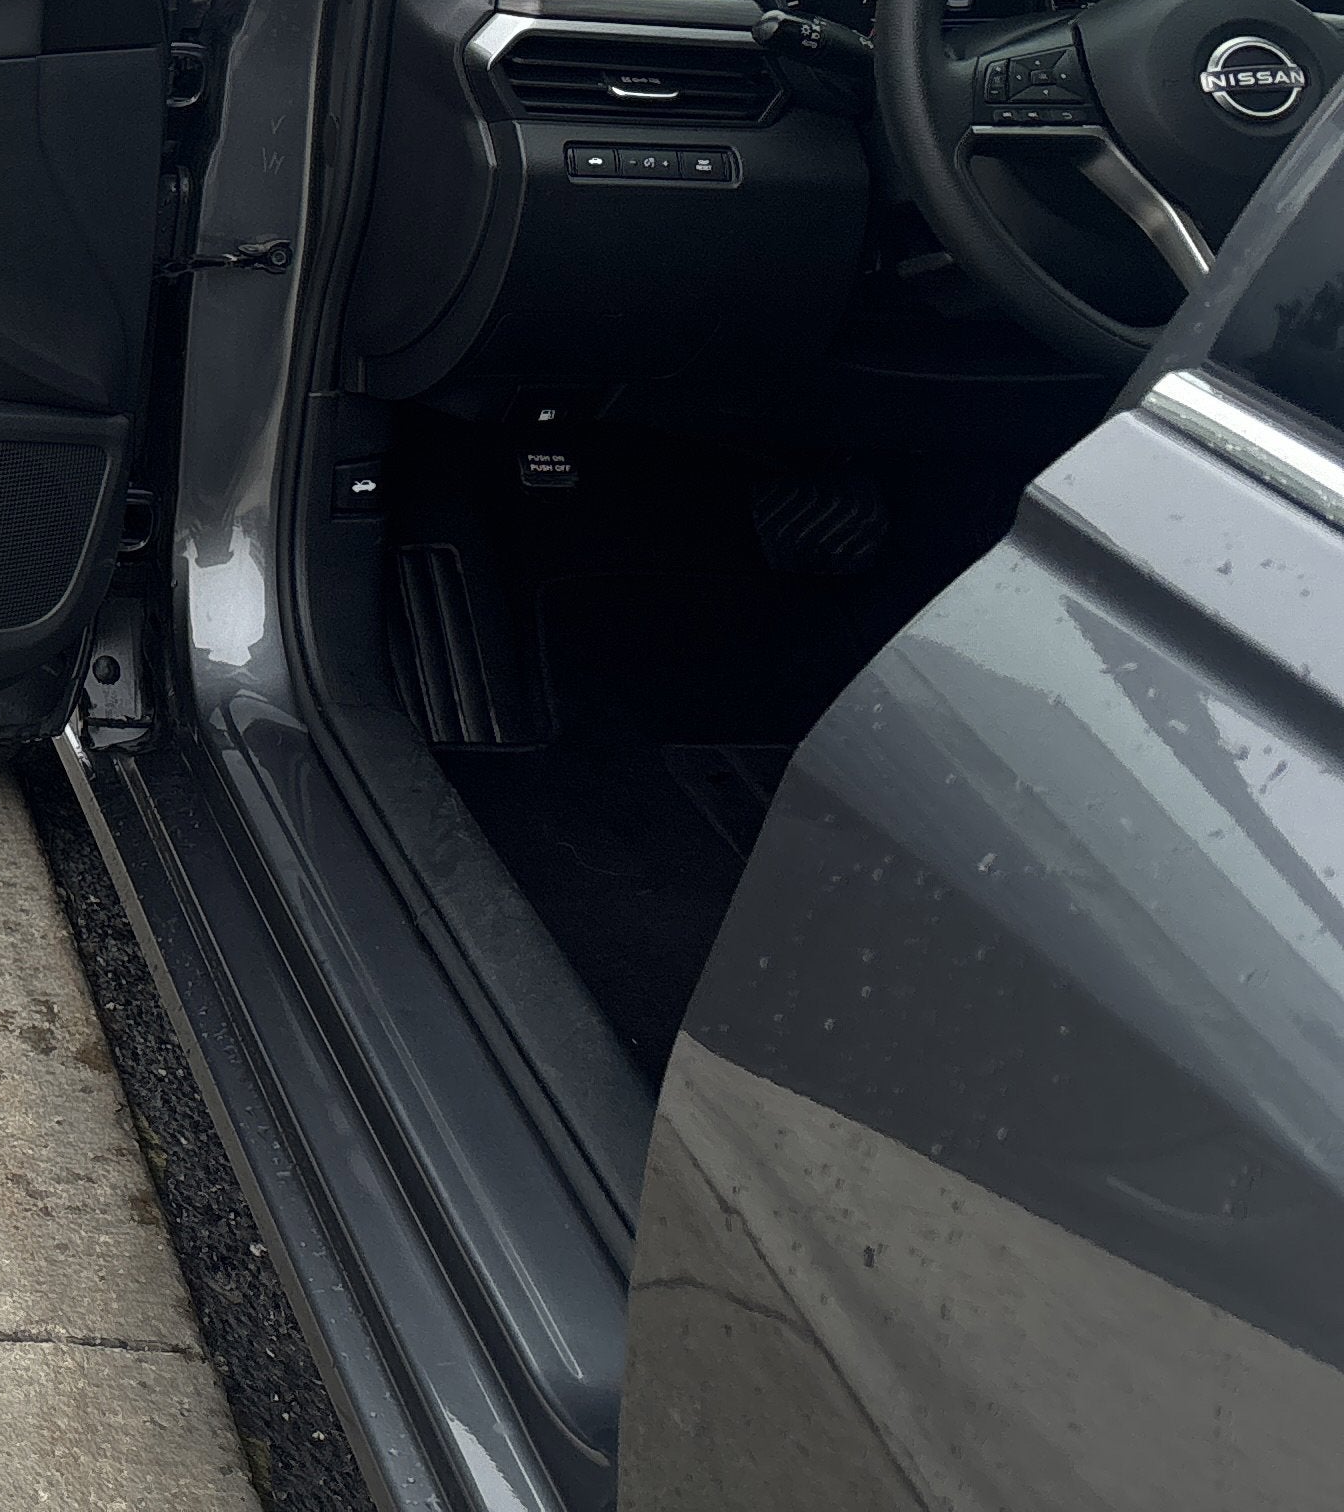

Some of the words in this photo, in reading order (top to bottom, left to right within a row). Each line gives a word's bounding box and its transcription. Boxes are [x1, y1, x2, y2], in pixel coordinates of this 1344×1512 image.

[1204, 70, 1305, 90] NISSAN
[527, 454, 551, 462] PUSH
[530, 463, 553, 472] PUSH
